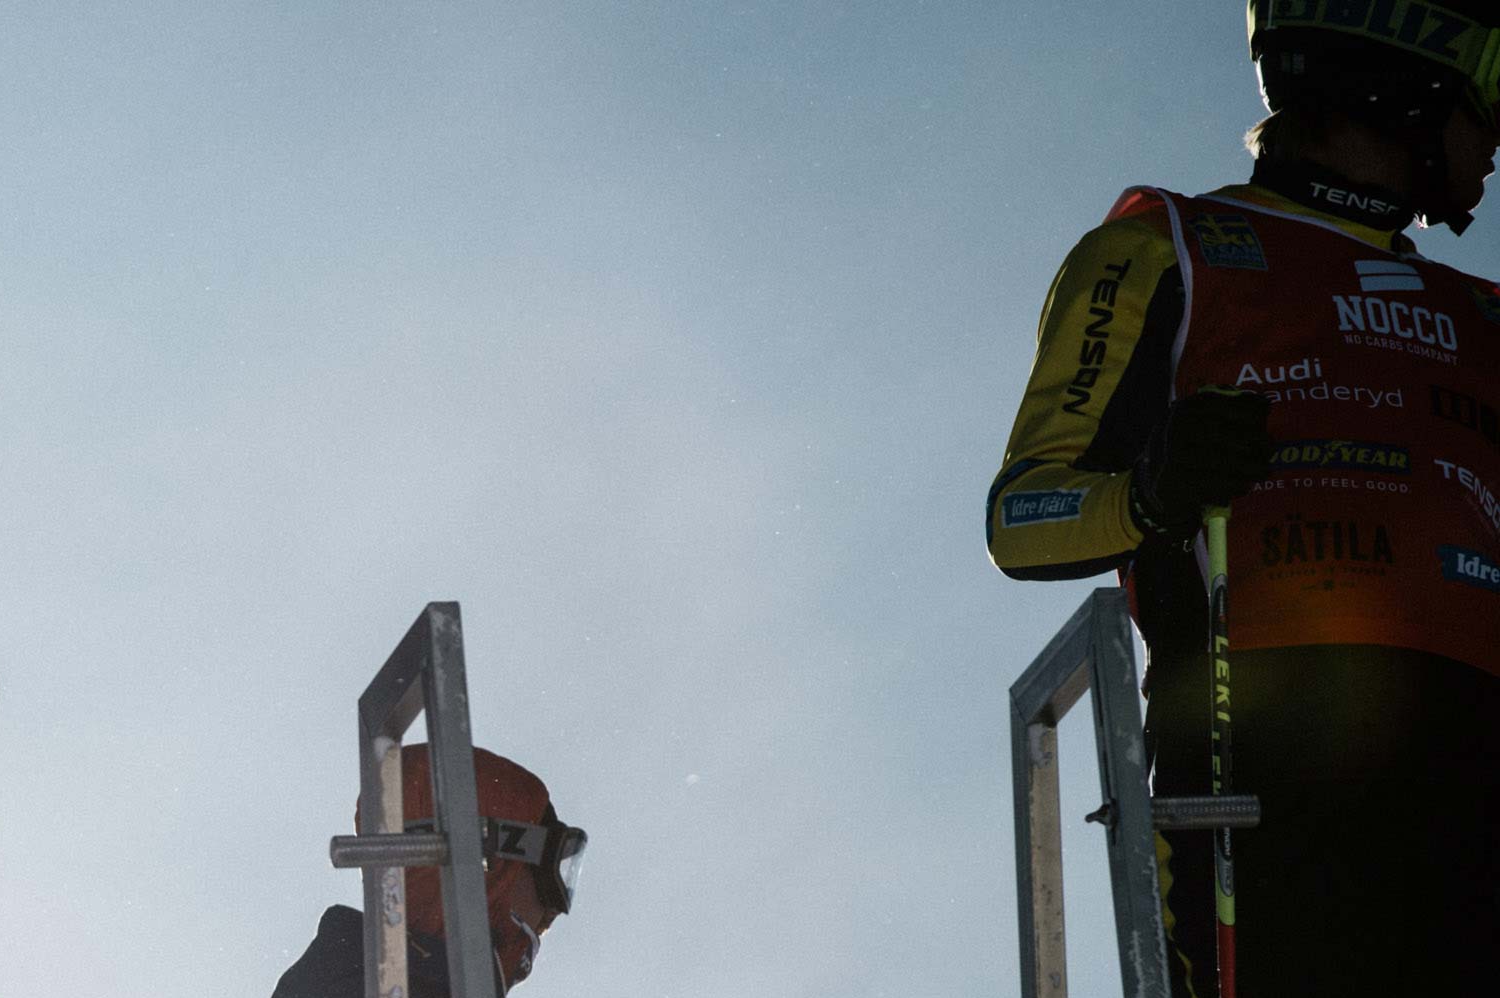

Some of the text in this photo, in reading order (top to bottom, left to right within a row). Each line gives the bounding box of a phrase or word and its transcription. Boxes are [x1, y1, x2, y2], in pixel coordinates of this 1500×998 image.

[1062, 258, 1132, 416] TENSON
[1332, 295, 1458, 352] NOCCO
[1236, 357, 1323, 386] Audi
[1269, 445, 1409, 470] ODYEAR
[1252, 477, 1410, 495] ADE TO FEEL GOOD
[1262, 513, 1396, 566] SÄTILA
[1456, 551, 1500, 585] Idre
[1214, 634, 1232, 723] LEKI
